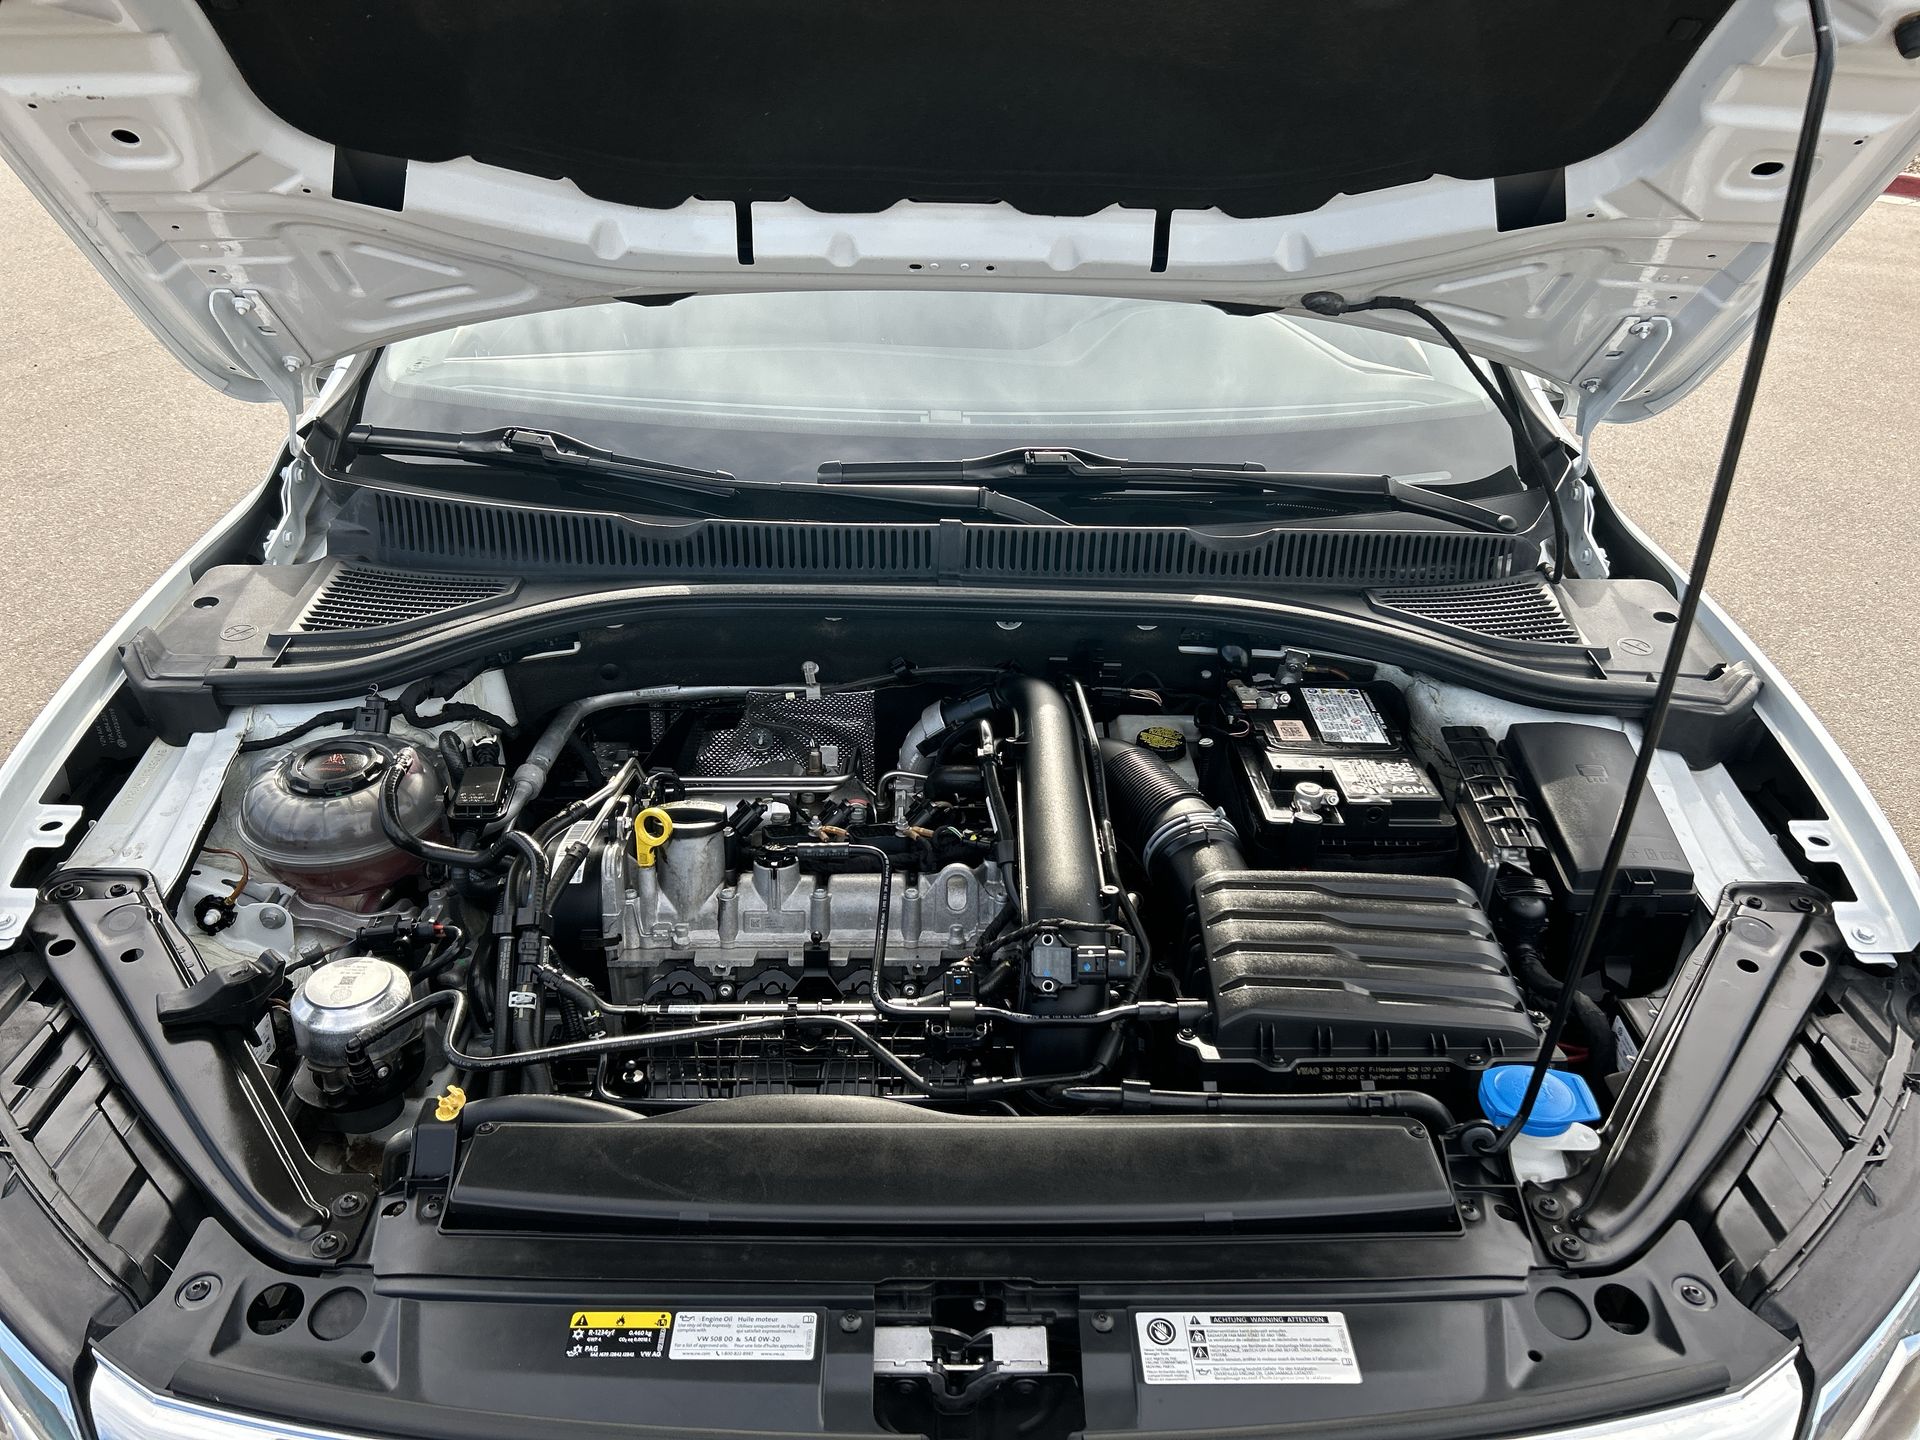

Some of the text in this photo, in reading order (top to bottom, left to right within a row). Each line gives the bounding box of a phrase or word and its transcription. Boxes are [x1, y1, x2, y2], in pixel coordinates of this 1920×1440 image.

[1392, 785, 1428, 794] AGM
[701, 1315, 734, 1324] Engine Oil
[588, 1329, 615, 1338] R-1234yf
